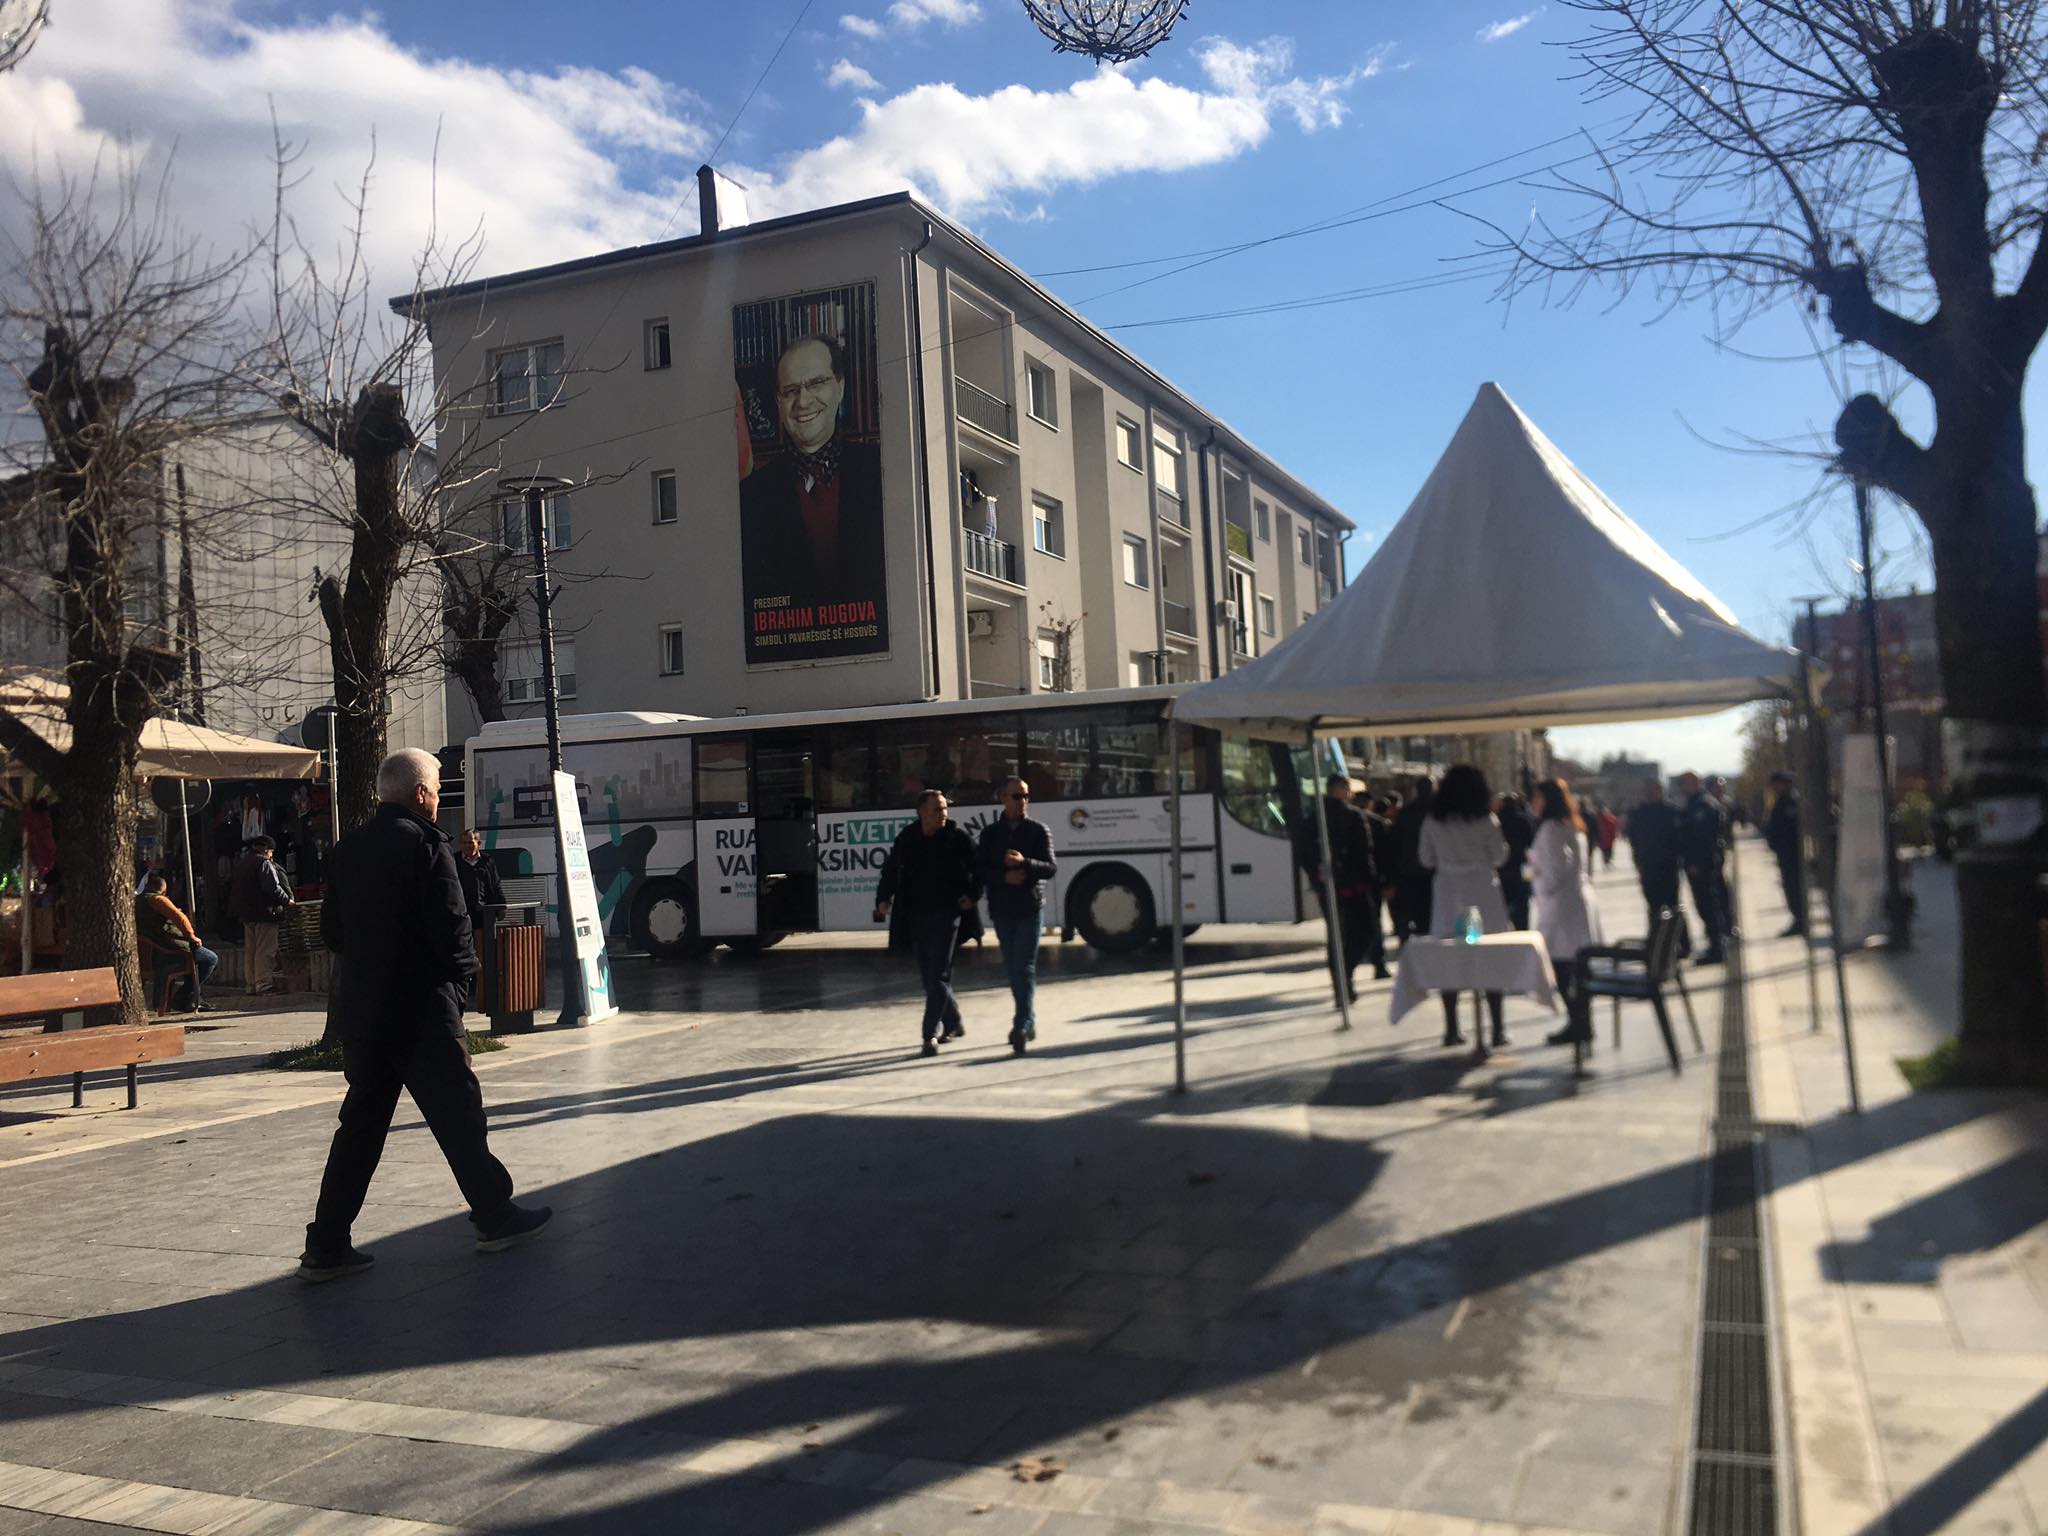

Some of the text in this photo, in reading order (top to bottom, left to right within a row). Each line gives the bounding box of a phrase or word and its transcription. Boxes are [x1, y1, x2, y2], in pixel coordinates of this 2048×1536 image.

[754, 596, 791, 609] PRESIDENT
[754, 601, 877, 632] IBRAHIM RUGOVA
[755, 635, 783, 647] SIMBOL
